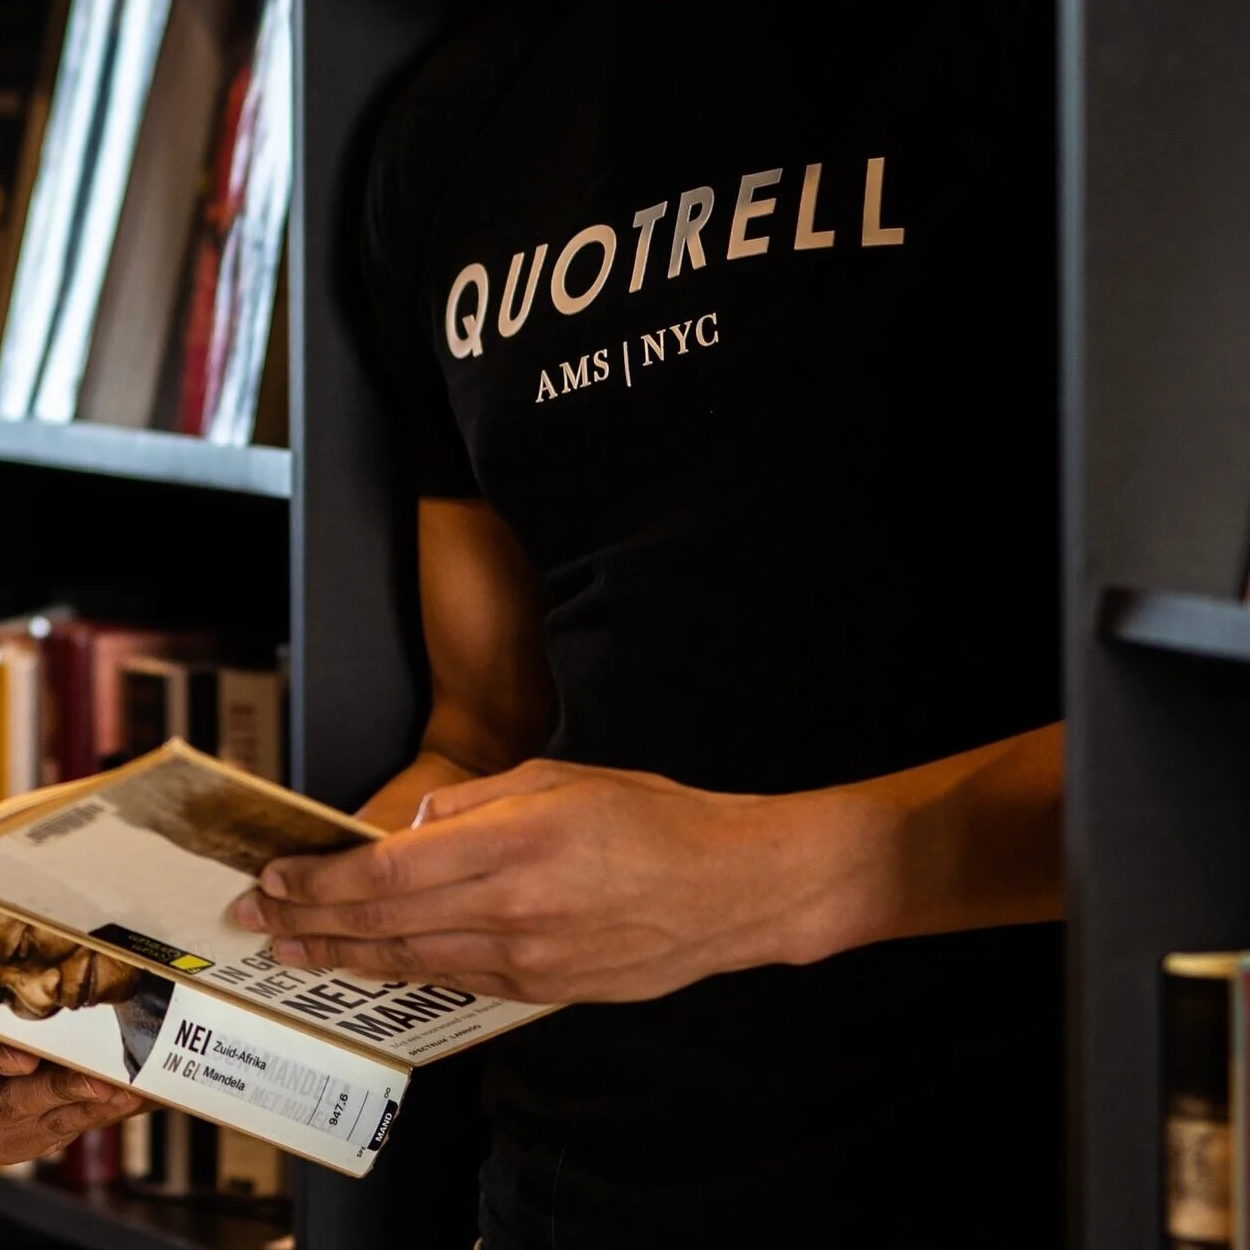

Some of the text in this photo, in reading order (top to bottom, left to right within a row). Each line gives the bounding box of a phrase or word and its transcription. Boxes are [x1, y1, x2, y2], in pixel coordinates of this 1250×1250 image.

[445, 157, 904, 359] QUOTRELL
[535, 348, 610, 403] AMS
[640, 312, 719, 367] NYC
[210, 965, 253, 985] IN
[244, 970, 305, 999] MET
[163, 1052, 183, 1073] IN
[213, 1040, 267, 1071] Zuid-Afrika
[202, 1065, 246, 1091] Mandela
[329, 1093, 349, 1126] 947.6
[375, 1112, 393, 1142] MAND
